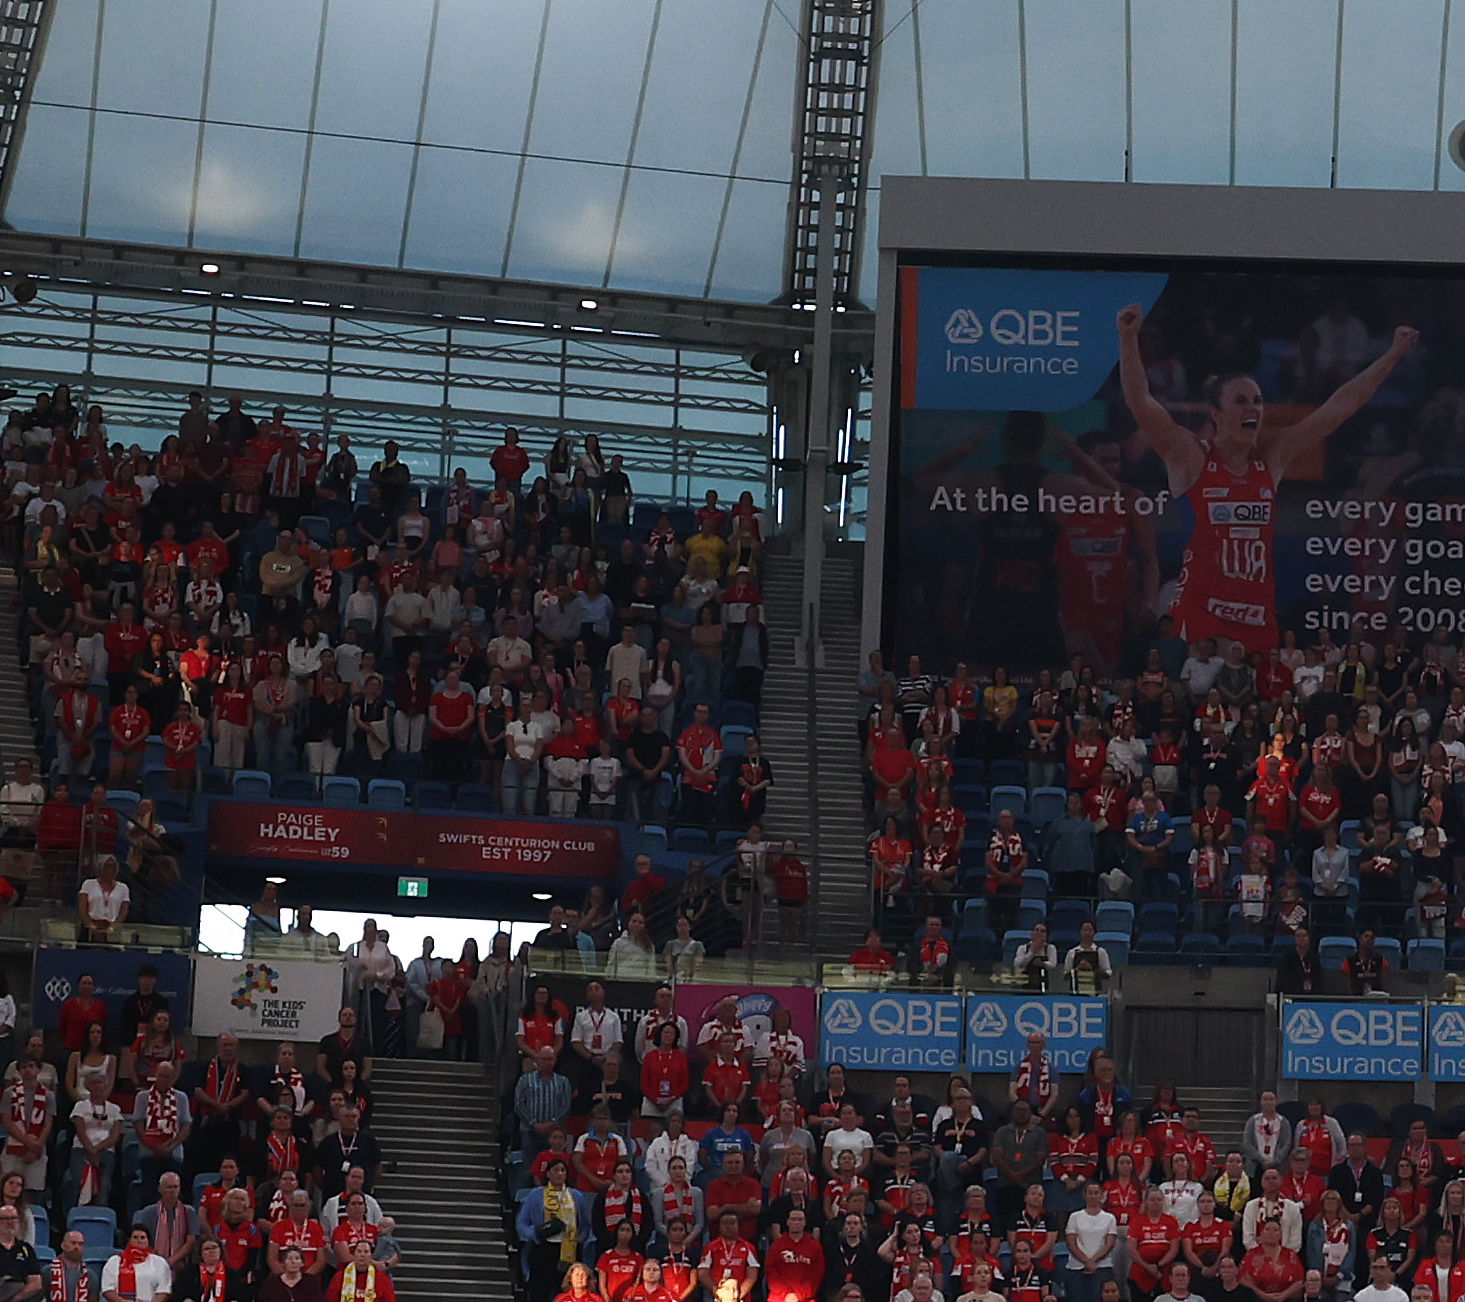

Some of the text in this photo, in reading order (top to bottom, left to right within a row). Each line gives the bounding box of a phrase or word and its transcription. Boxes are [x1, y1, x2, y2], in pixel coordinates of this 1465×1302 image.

[990, 308, 1080, 347] QBE
[946, 349, 1080, 375] Insurance
[929, 485, 1170, 516] At the heart of
[1234, 503, 1271, 522] QBE
[1305, 498, 1396, 527] every
[1305, 535, 1396, 564] every
[1304, 571, 1397, 600] every
[1304, 604, 1388, 631] since
[259, 823, 341, 843] HADLEY
[277, 812, 324, 827] PAIGE
[438, 832, 596, 852] SWIFTS CENTURION CLUB
[481, 846, 553, 863] EST 1997
[261, 1008, 298, 1019] CANCER
[262, 999, 279, 1009] THE
[260, 1017, 301, 1029] PROJECT
[868, 999, 960, 1038] QBE
[1014, 1001, 1105, 1039] QBE
[1331, 1008, 1420, 1047] QBE
[825, 1039, 957, 1067] Insurance
[1287, 1049, 1420, 1076] Insurance
